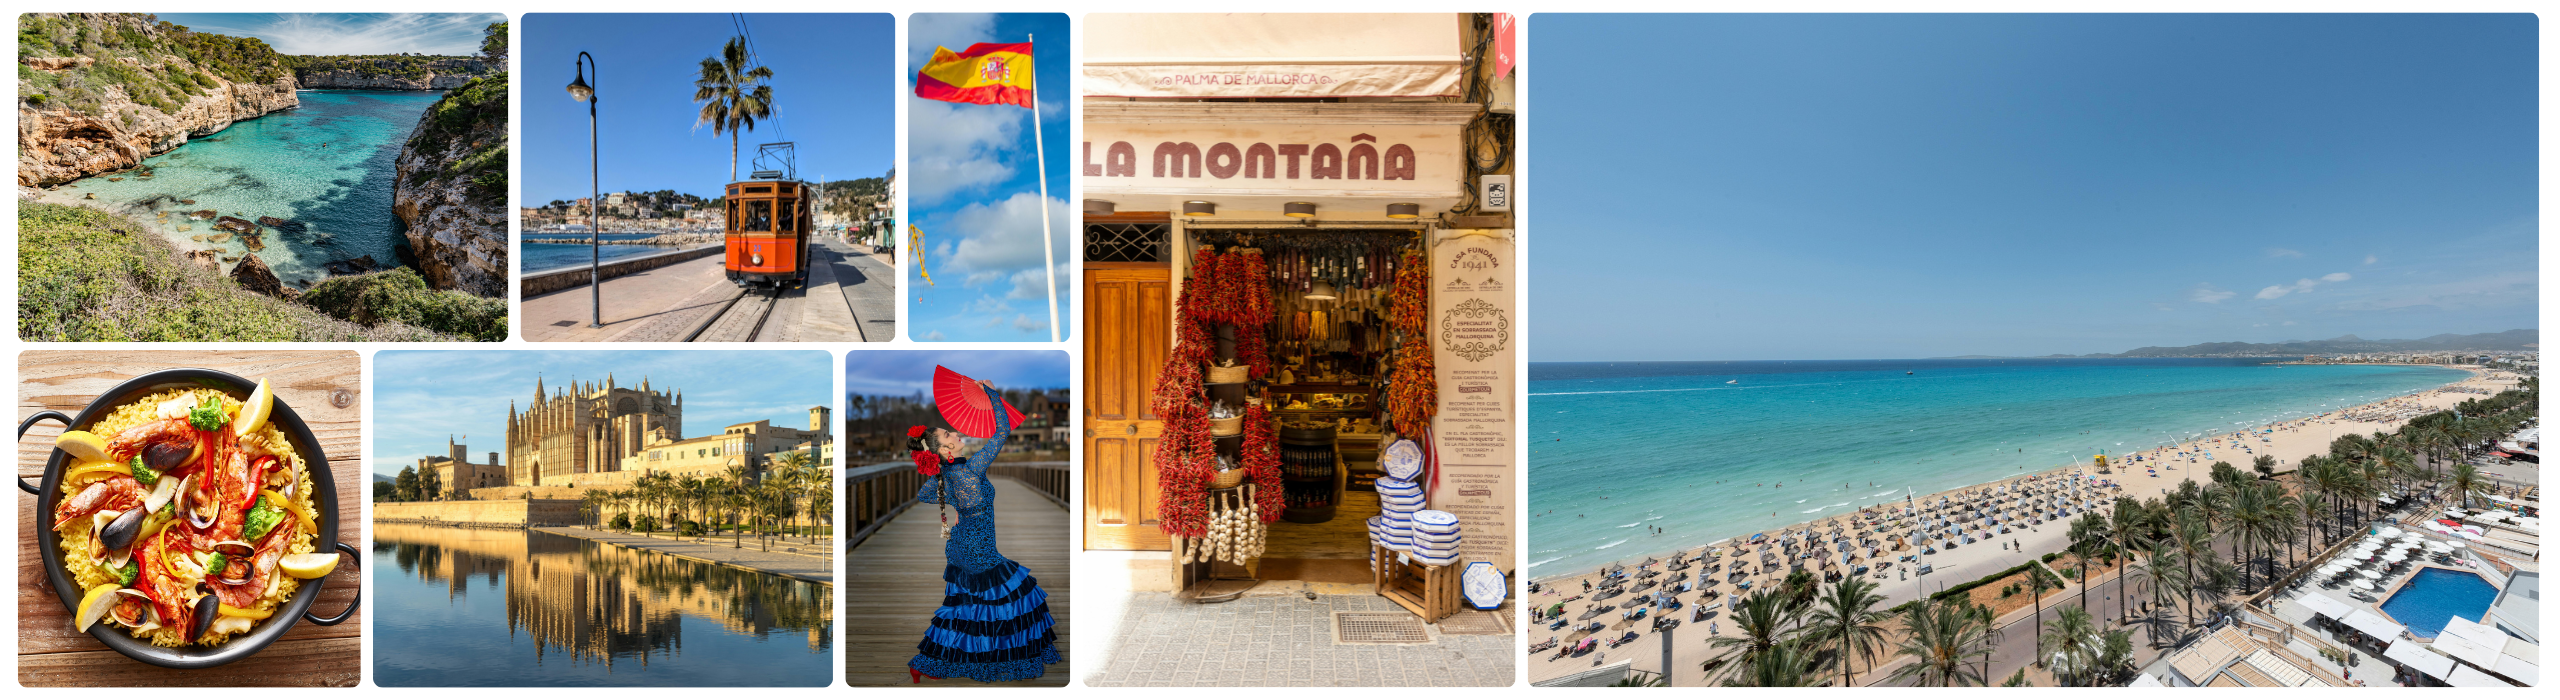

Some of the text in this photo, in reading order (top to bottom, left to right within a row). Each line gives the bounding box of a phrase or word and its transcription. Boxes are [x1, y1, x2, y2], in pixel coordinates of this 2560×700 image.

[1175, 74, 1317, 86] PALMA DE MALLORCA
[1083, 132, 1416, 180] LA MONTAÑA
[1450, 247, 1499, 269] CASA FUNDADA
[1462, 261, 1487, 272] 1941
